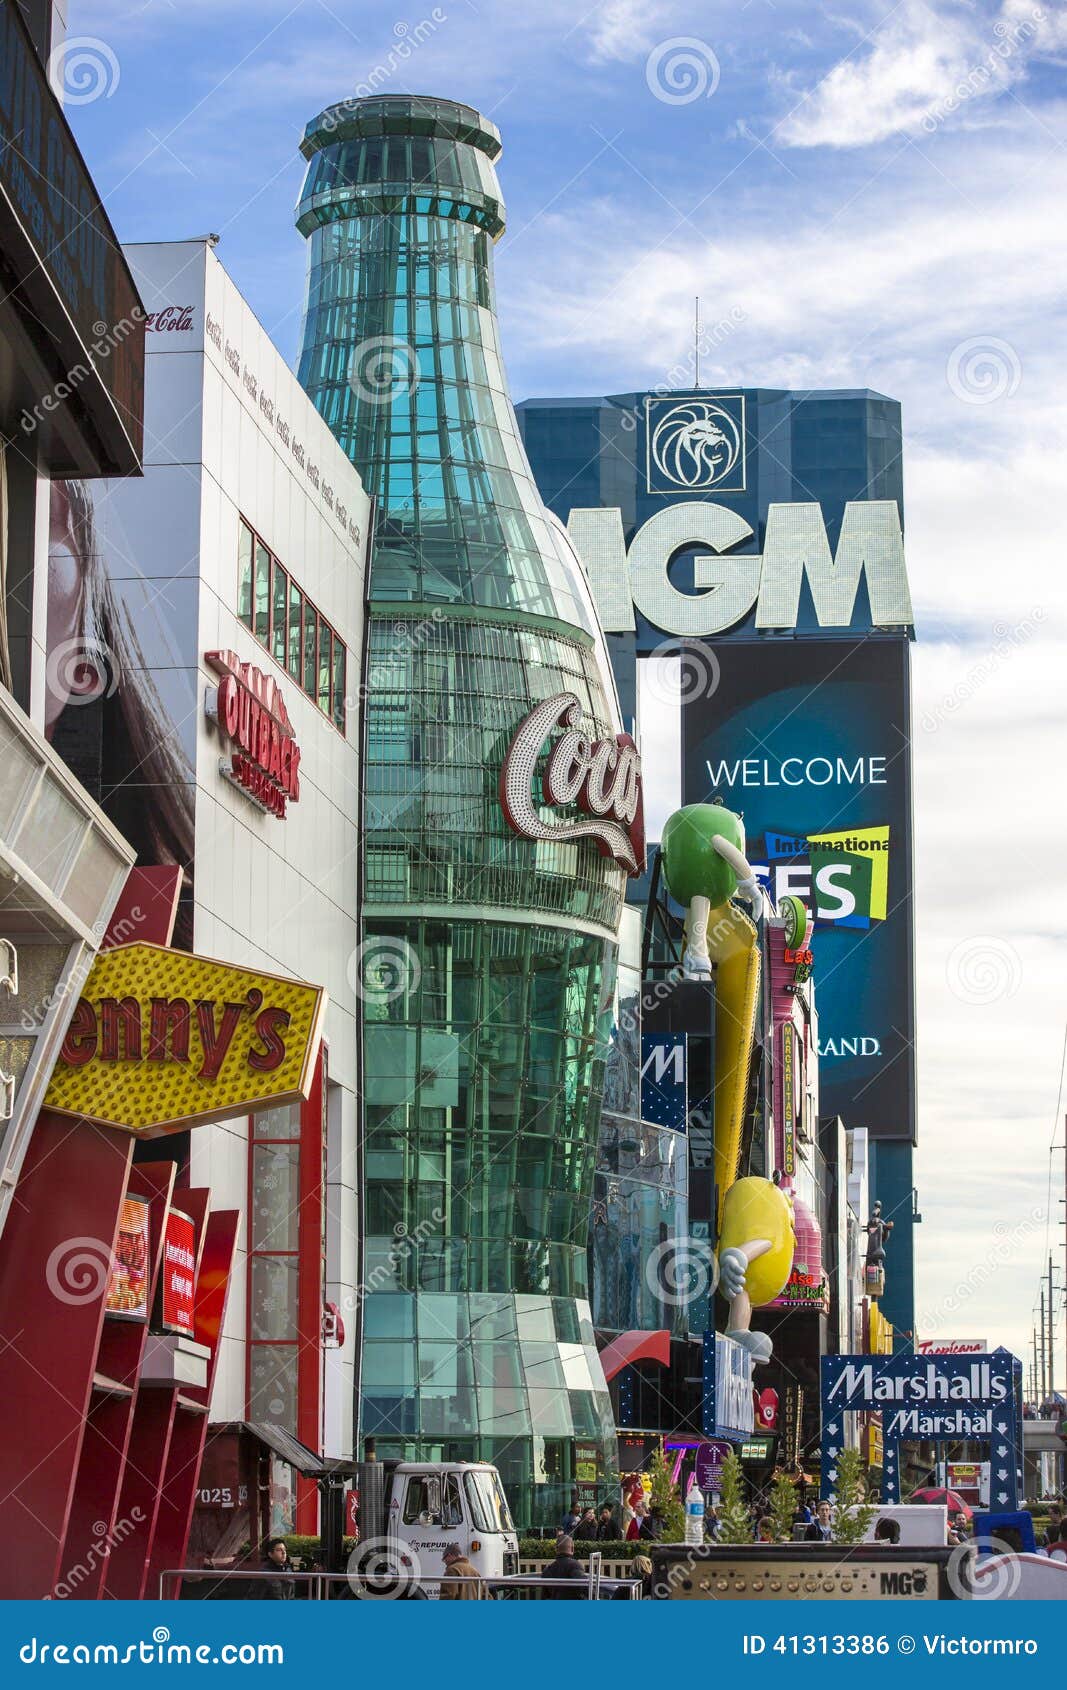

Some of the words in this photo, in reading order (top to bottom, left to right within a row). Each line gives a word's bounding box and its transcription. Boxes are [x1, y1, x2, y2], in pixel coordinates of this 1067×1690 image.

[502, 692, 646, 879] Coca
[706, 757, 888, 787] WELCOME
[641, 1045, 684, 1083] M
[827, 1363, 1007, 1400] Marshalls
[887, 1410, 993, 1433] Marshal
